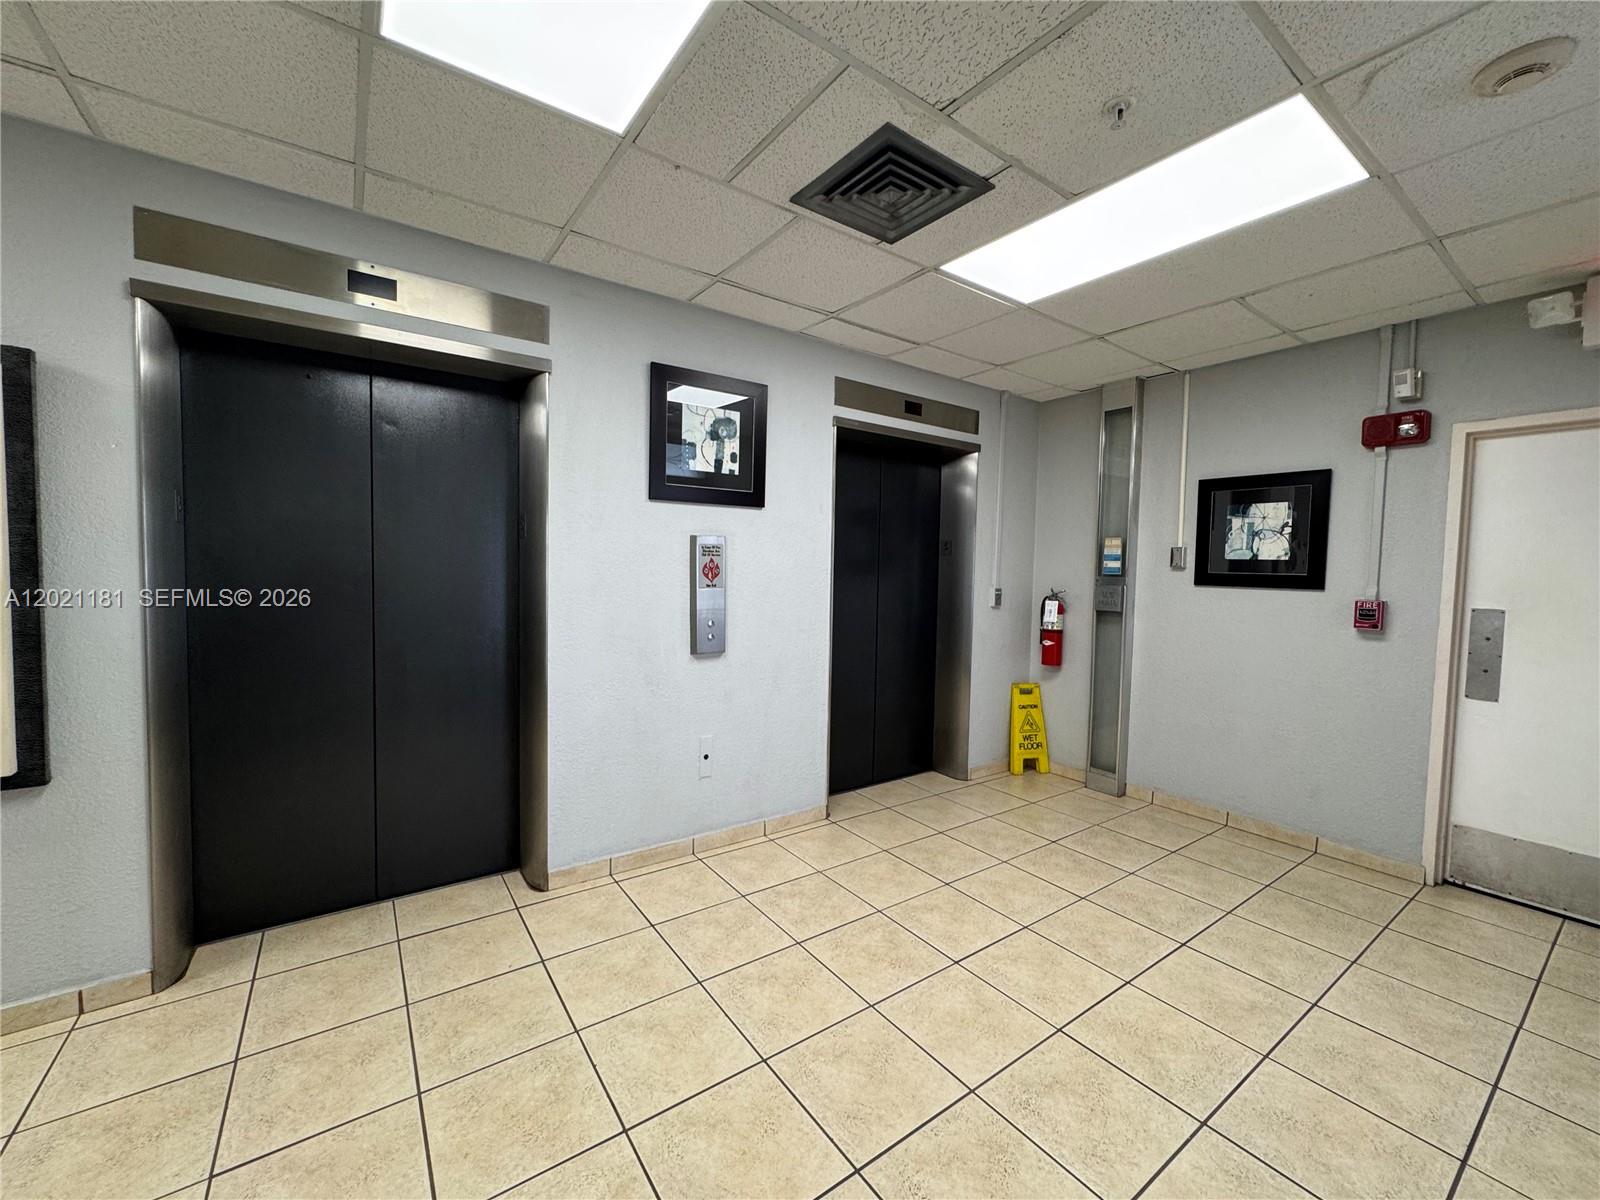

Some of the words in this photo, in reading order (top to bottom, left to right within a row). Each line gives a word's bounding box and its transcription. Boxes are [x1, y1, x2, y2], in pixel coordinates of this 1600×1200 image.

[1357, 601, 1379, 609] FIRE
[1023, 734, 1039, 742] WET
[1018, 742, 1043, 751] FLOOR
